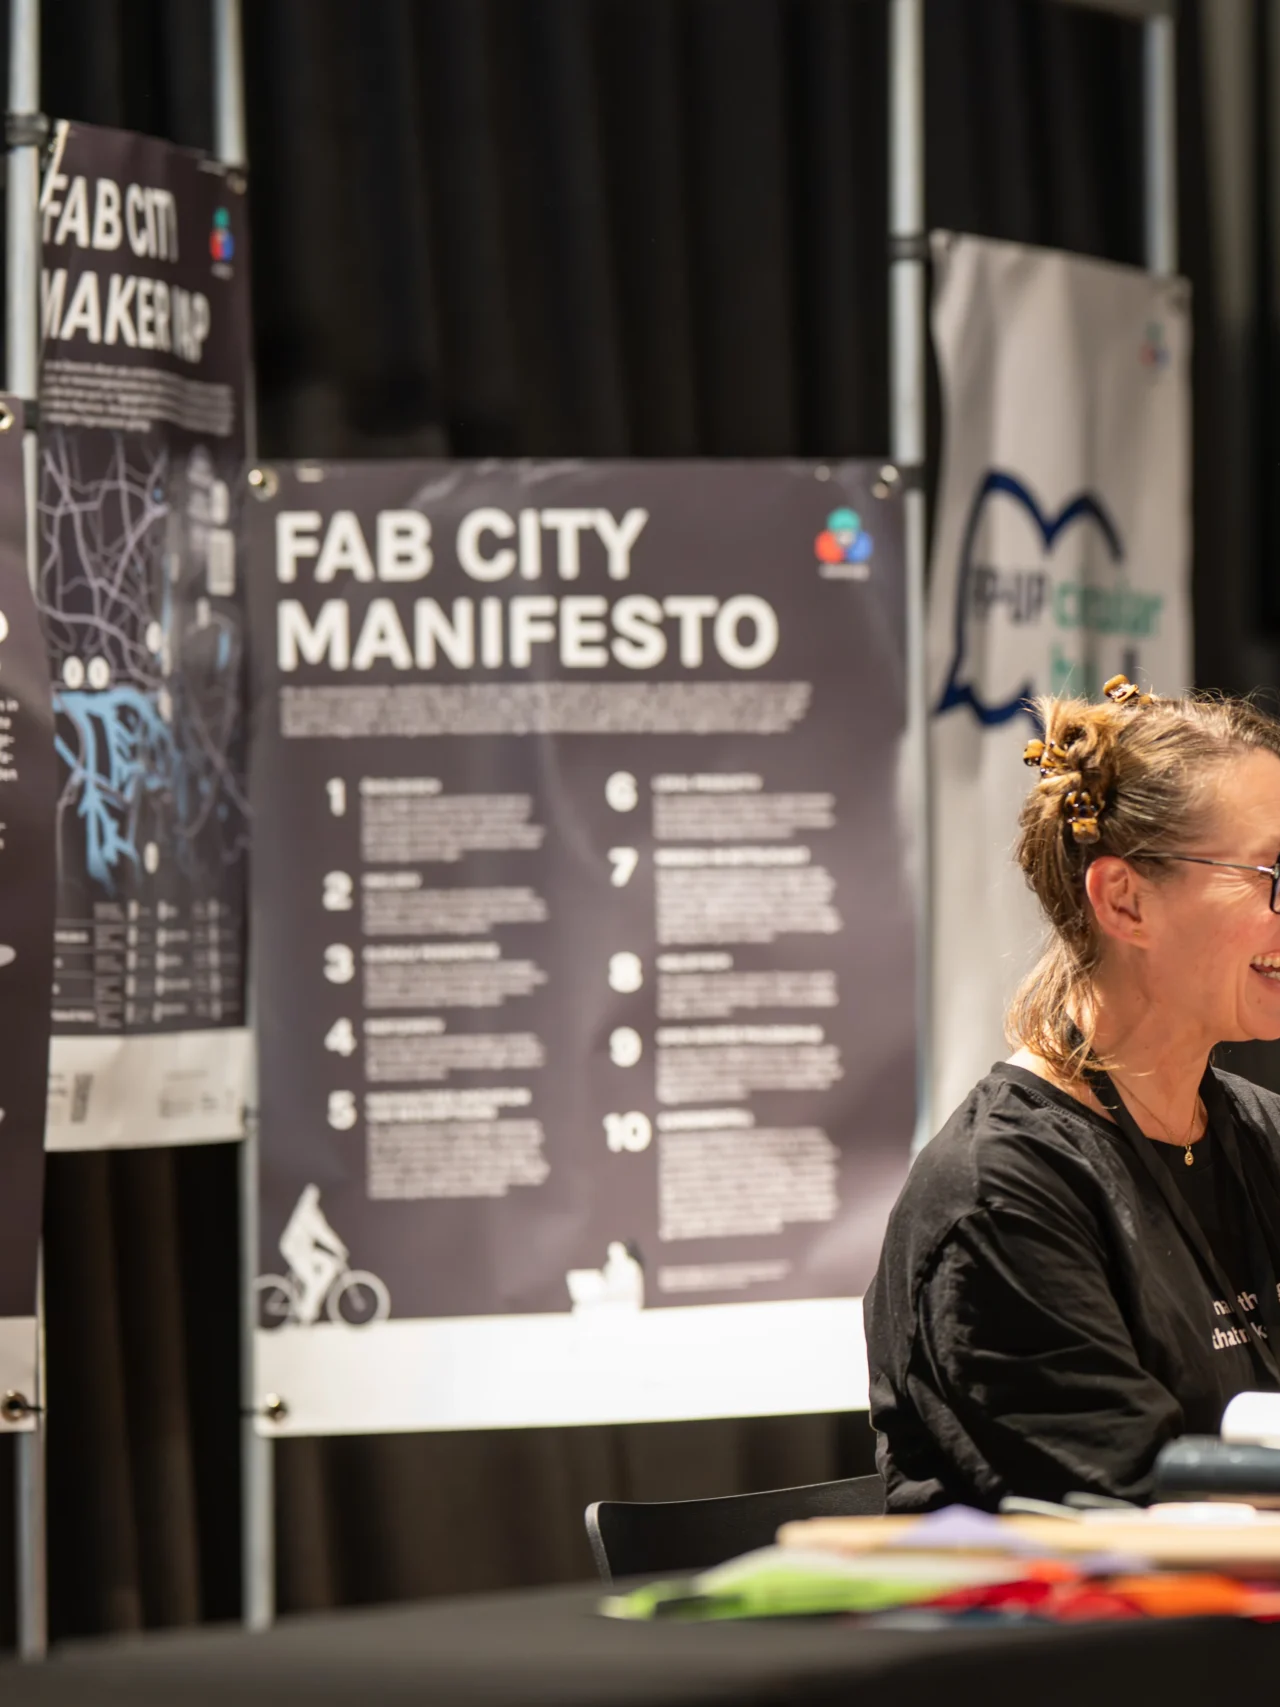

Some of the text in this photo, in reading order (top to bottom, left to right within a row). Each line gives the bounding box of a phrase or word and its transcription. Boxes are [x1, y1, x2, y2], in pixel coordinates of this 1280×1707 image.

[275, 507, 649, 584] FAB CITY
[276, 594, 779, 672] MANIFESTO
[326, 777, 347, 817] 1
[604, 770, 639, 813] 6
[607, 846, 639, 888] 7
[322, 870, 354, 912] 2
[323, 943, 355, 984] 3
[607, 950, 644, 994] 8
[324, 1017, 357, 1057] 4
[609, 1026, 643, 1068] 9
[327, 1089, 358, 1131] 5
[602, 1110, 652, 1153] 10
